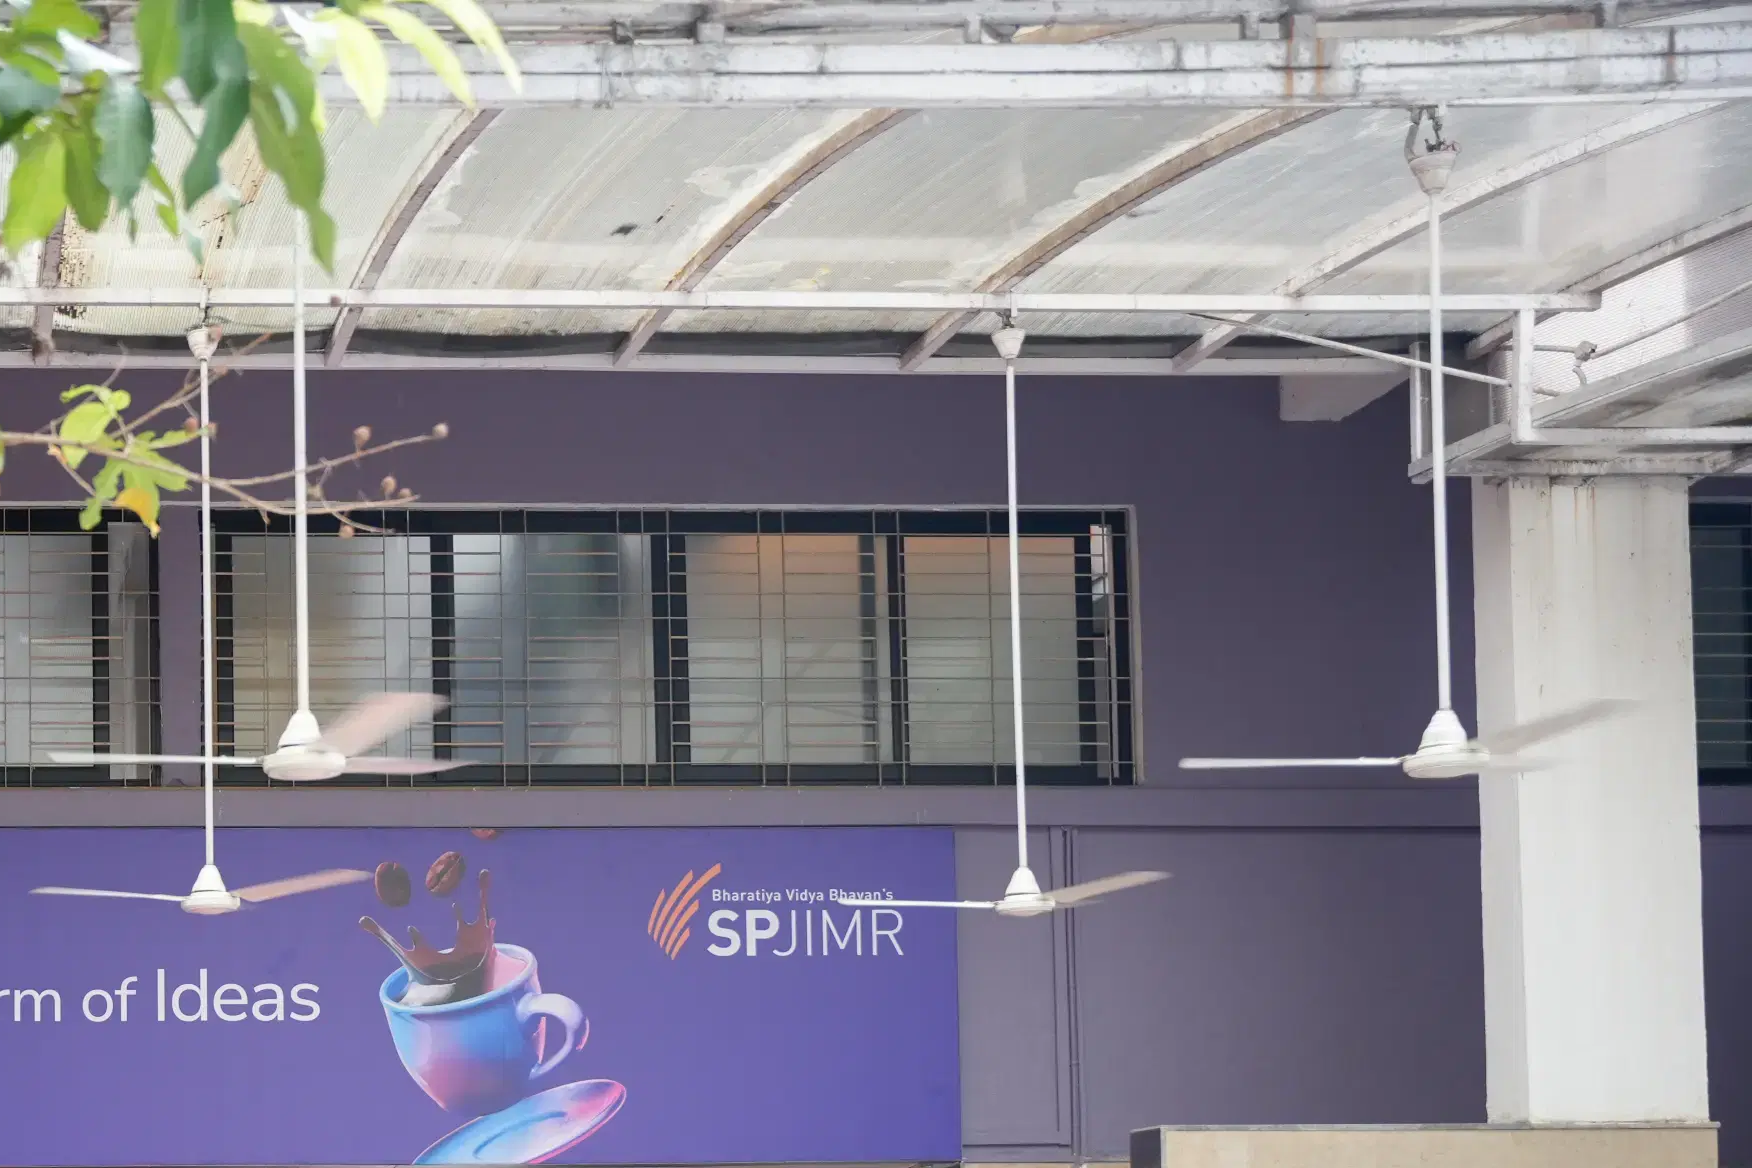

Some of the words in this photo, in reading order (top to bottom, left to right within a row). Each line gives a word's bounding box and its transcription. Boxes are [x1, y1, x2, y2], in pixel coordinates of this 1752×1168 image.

[712, 889, 782, 904] Bharatiya
[786, 889, 824, 904] Vidya
[707, 909, 904, 957] SPJIMR
[82, 976, 137, 1022] of
[157, 968, 321, 1022] Ideas
